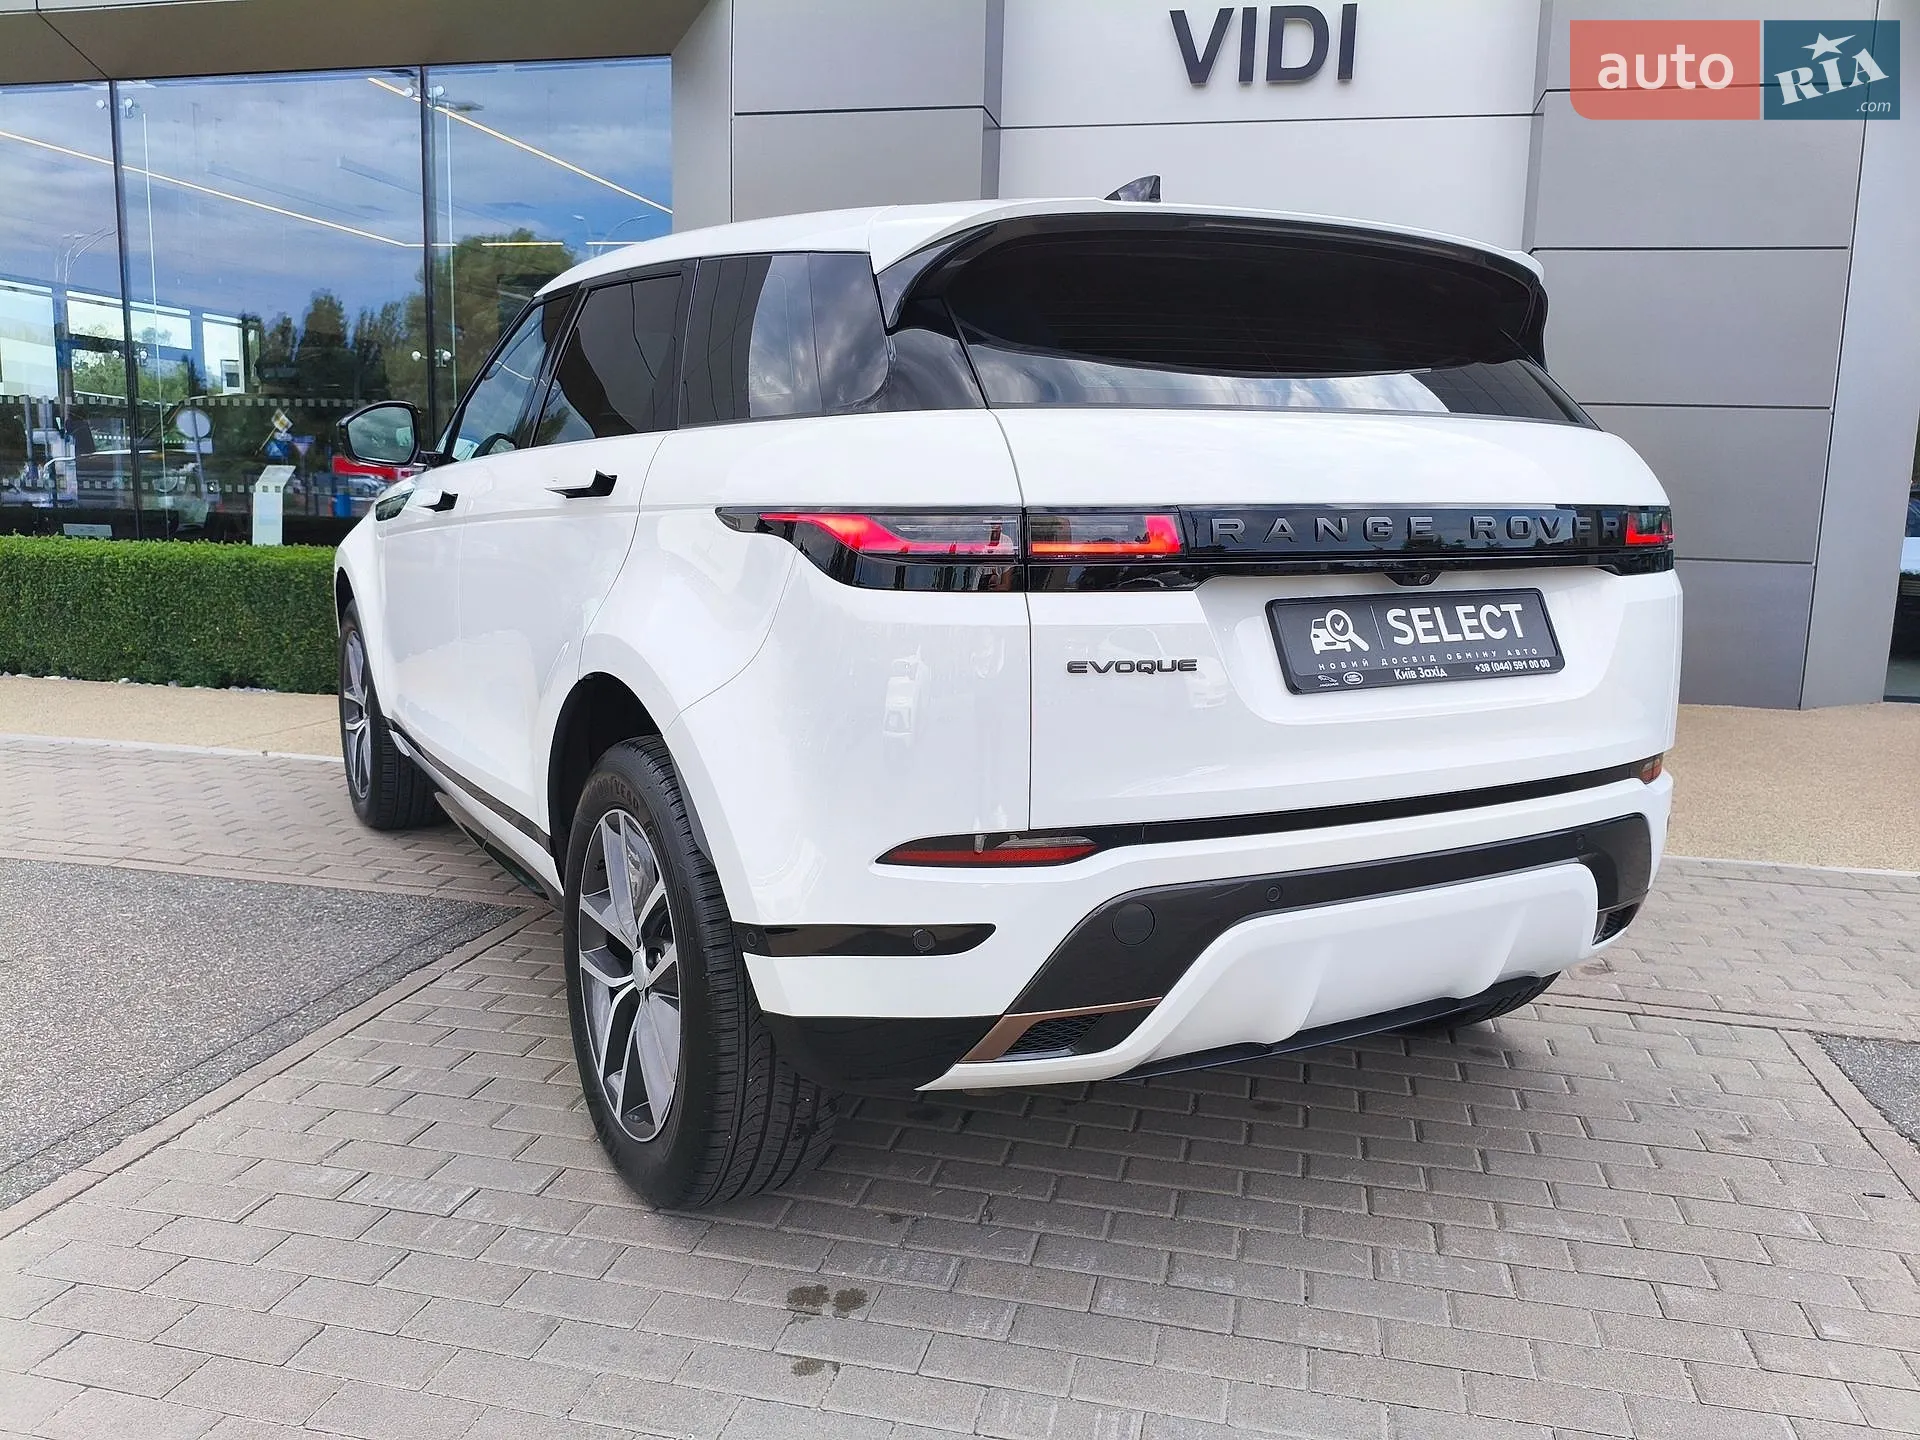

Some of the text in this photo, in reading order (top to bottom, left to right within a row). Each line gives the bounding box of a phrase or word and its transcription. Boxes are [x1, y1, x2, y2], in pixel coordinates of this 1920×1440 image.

[1169, 3, 1357, 84] VIDI
[1210, 515, 1620, 544] RANGE ROVER
[1386, 603, 1524, 646] SELECT
[1066, 659, 1198, 675] EVOQUE
[1318, 648, 1538, 671] НОВИЙ ДОСВІД ОБМІНУ АВТО
[1475, 658, 1551, 673] +38 (044) 591 00 00
[1393, 665, 1448, 680] Київ Захід
